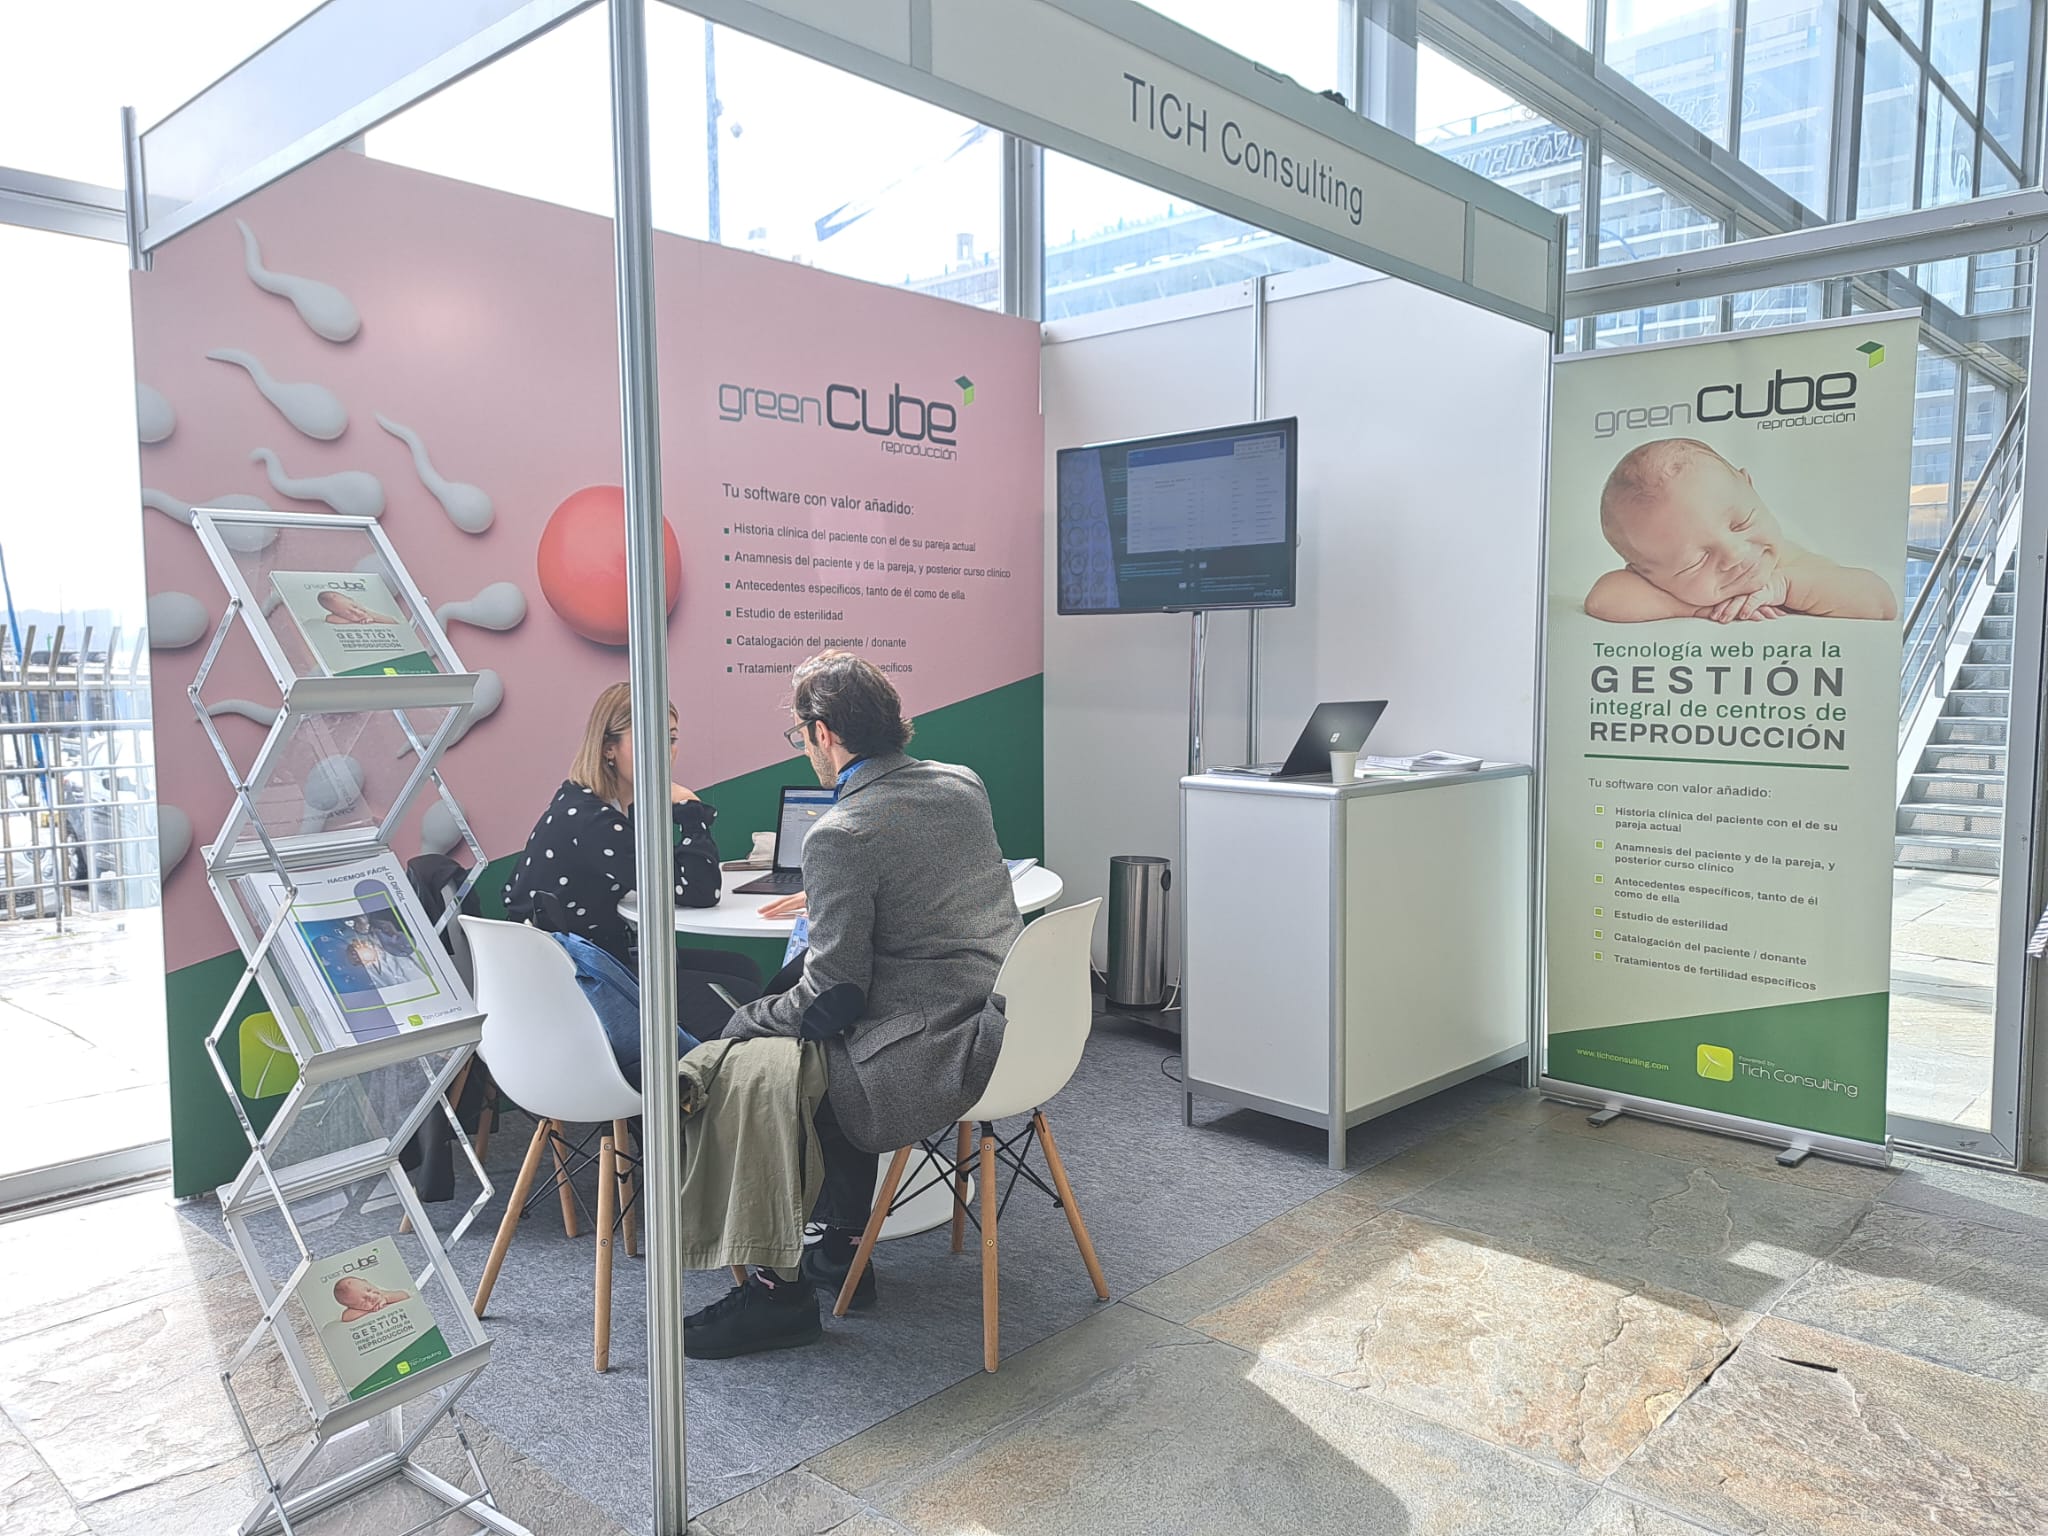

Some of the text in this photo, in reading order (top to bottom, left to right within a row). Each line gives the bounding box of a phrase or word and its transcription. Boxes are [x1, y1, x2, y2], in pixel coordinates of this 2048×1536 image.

[1123, 72, 1363, 225] TICH Consulting
[1756, 411, 1856, 431] reproducción
[881, 439, 958, 461] reproducción
[722, 482, 915, 516] Tu software con valor añadido:
[733, 522, 976, 552] Historia clínica del paciente con el de su pareja actual
[734, 551, 1011, 578] Anamnesis del paciente y de la pareja, y posterior curso clínico
[735, 579, 966, 601] Antecedentes específicos, tanto de él como de ella
[735, 607, 844, 621] Estudio de esterilidad
[736, 634, 907, 650] Catalogación del paciente / donante
[1593, 641, 1842, 663] Tecnología web para la
[1590, 660, 1844, 697] GESTIÓN
[1590, 698, 1847, 722] integral de centros de
[1590, 721, 1846, 751] REPRODUCCIÓN
[1588, 777, 1772, 799] Tu software con valor añadido:
[1615, 807, 1838, 831] Historia clínica del paciente con el de su
[1615, 821, 1682, 833] pareja actual
[1615, 842, 1836, 872] Anamnesis del paciente y de la pareja, y
[1615, 855, 1735, 874] posterior curso clínico
[327, 872, 366, 884] HACEMOS
[1614, 876, 1819, 906] Antecedentes específicos, tanto de él
[1614, 890, 1680, 904] como de ella
[1614, 910, 1728, 932] Estudio de esterilidad
[1614, 932, 1807, 966] Catalogación del paciente / donante
[1614, 954, 1817, 991] Tratamientos de fertilidad específicos
[1575, 1048, 1669, 1071] www.tichconsulting.com
[1738, 1062, 1858, 1098] Tich Consulting
